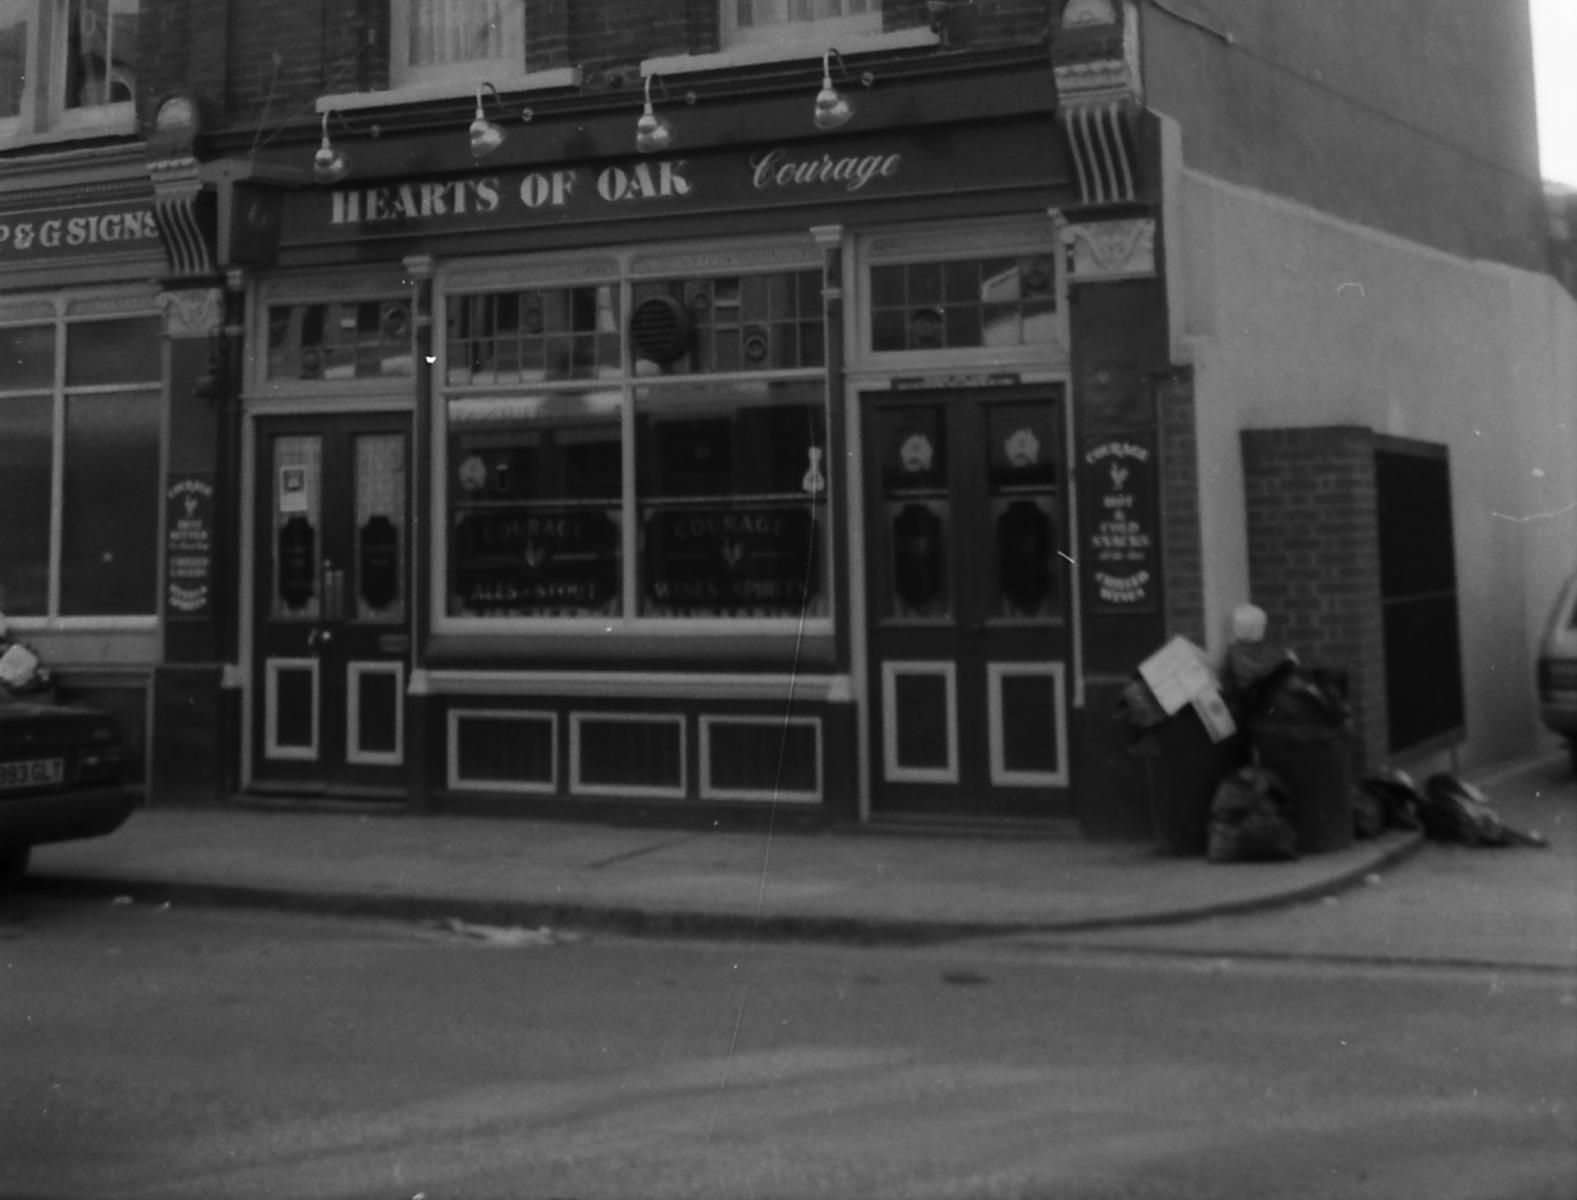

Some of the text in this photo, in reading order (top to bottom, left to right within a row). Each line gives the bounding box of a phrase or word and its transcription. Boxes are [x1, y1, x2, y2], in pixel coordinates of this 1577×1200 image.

[750, 149, 900, 191] Courage
[330, 160, 691, 224] HEARTS OF OAK
[66, 211, 159, 245] SIGNS
[1086, 442, 1149, 464] COURAGE
[673, 514, 784, 540] COURAGE
